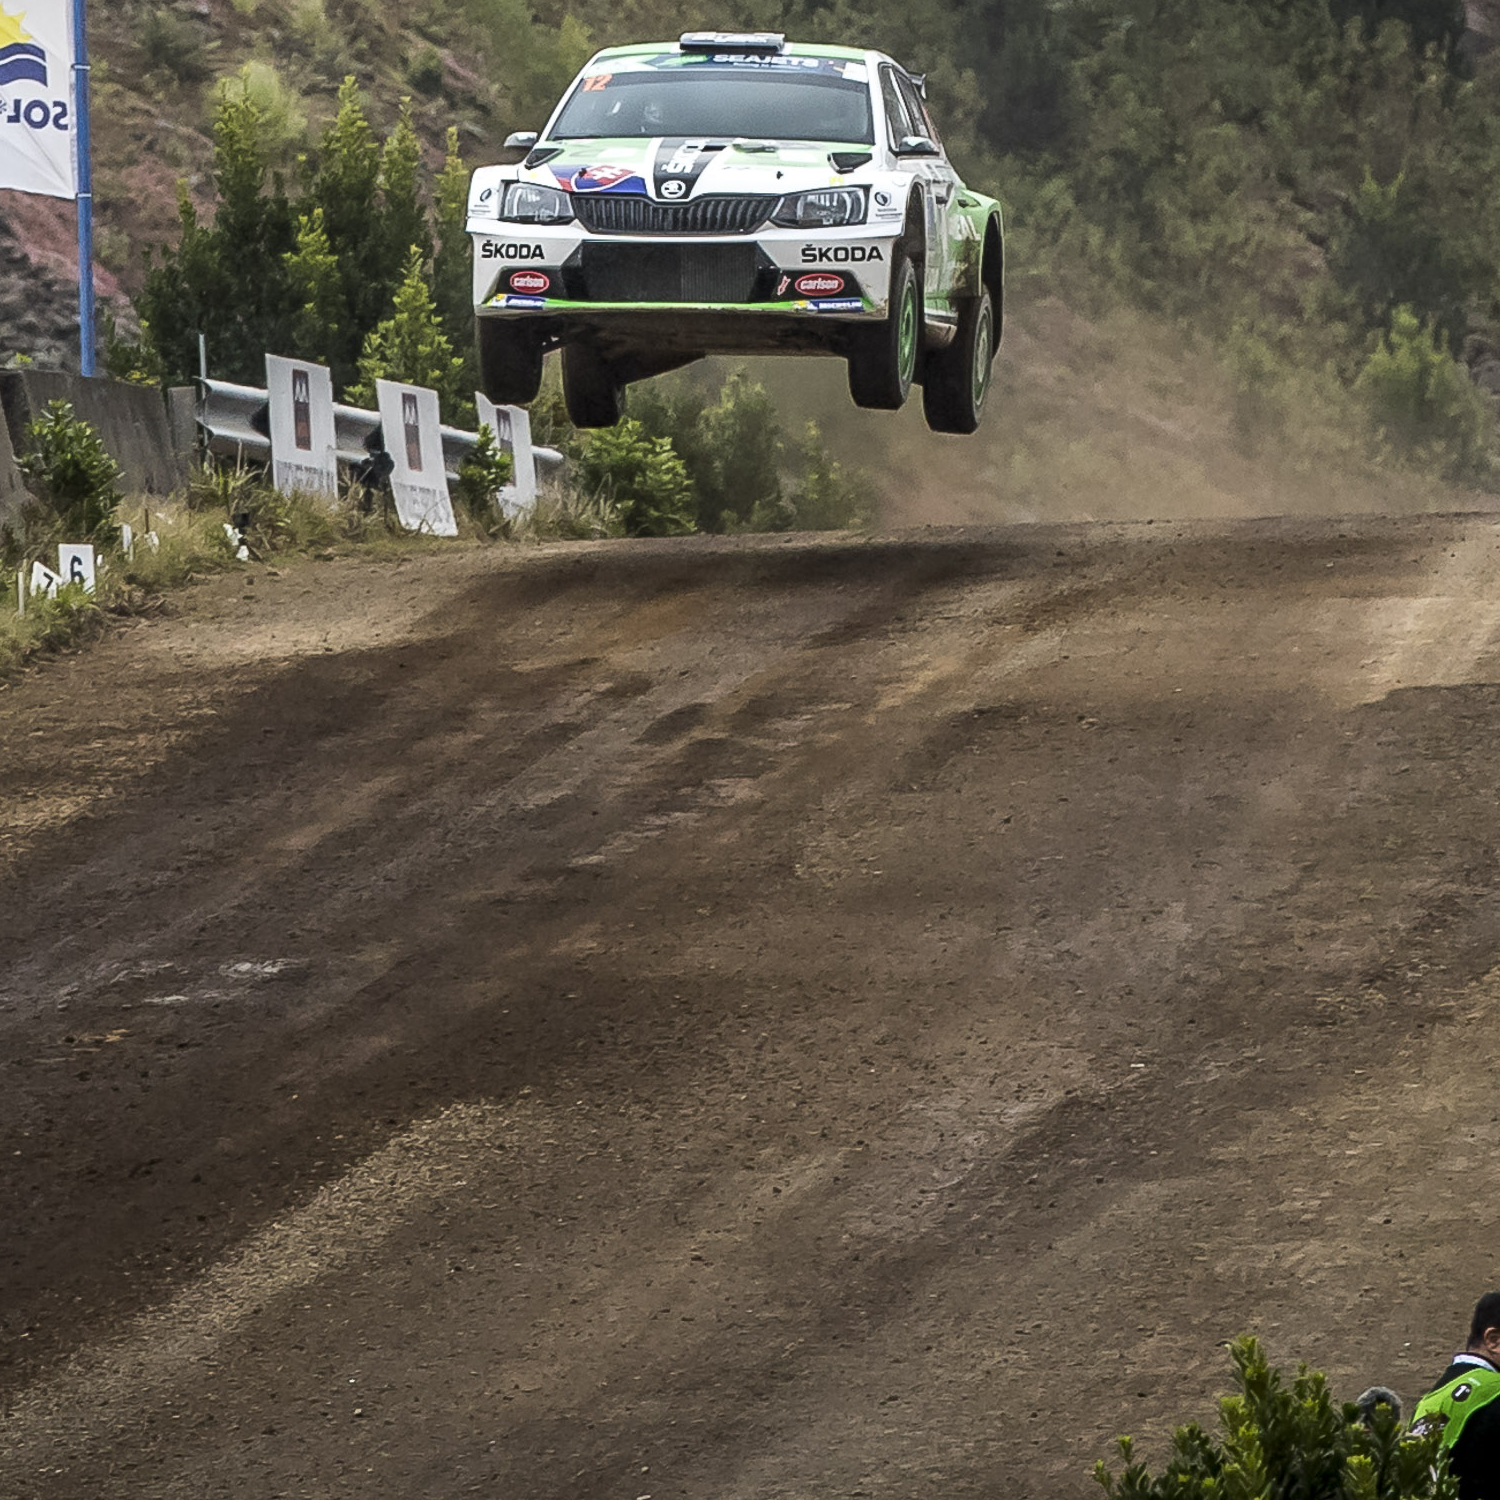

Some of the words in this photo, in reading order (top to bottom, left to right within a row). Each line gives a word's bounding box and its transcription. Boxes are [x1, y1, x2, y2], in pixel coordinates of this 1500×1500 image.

[583, 74, 613, 92] 12
[481, 240, 545, 260] ŠKODA
[801, 244, 884, 263] ŠKODA
[800, 277, 839, 290] carlson
[70, 555, 83, 583] 6
